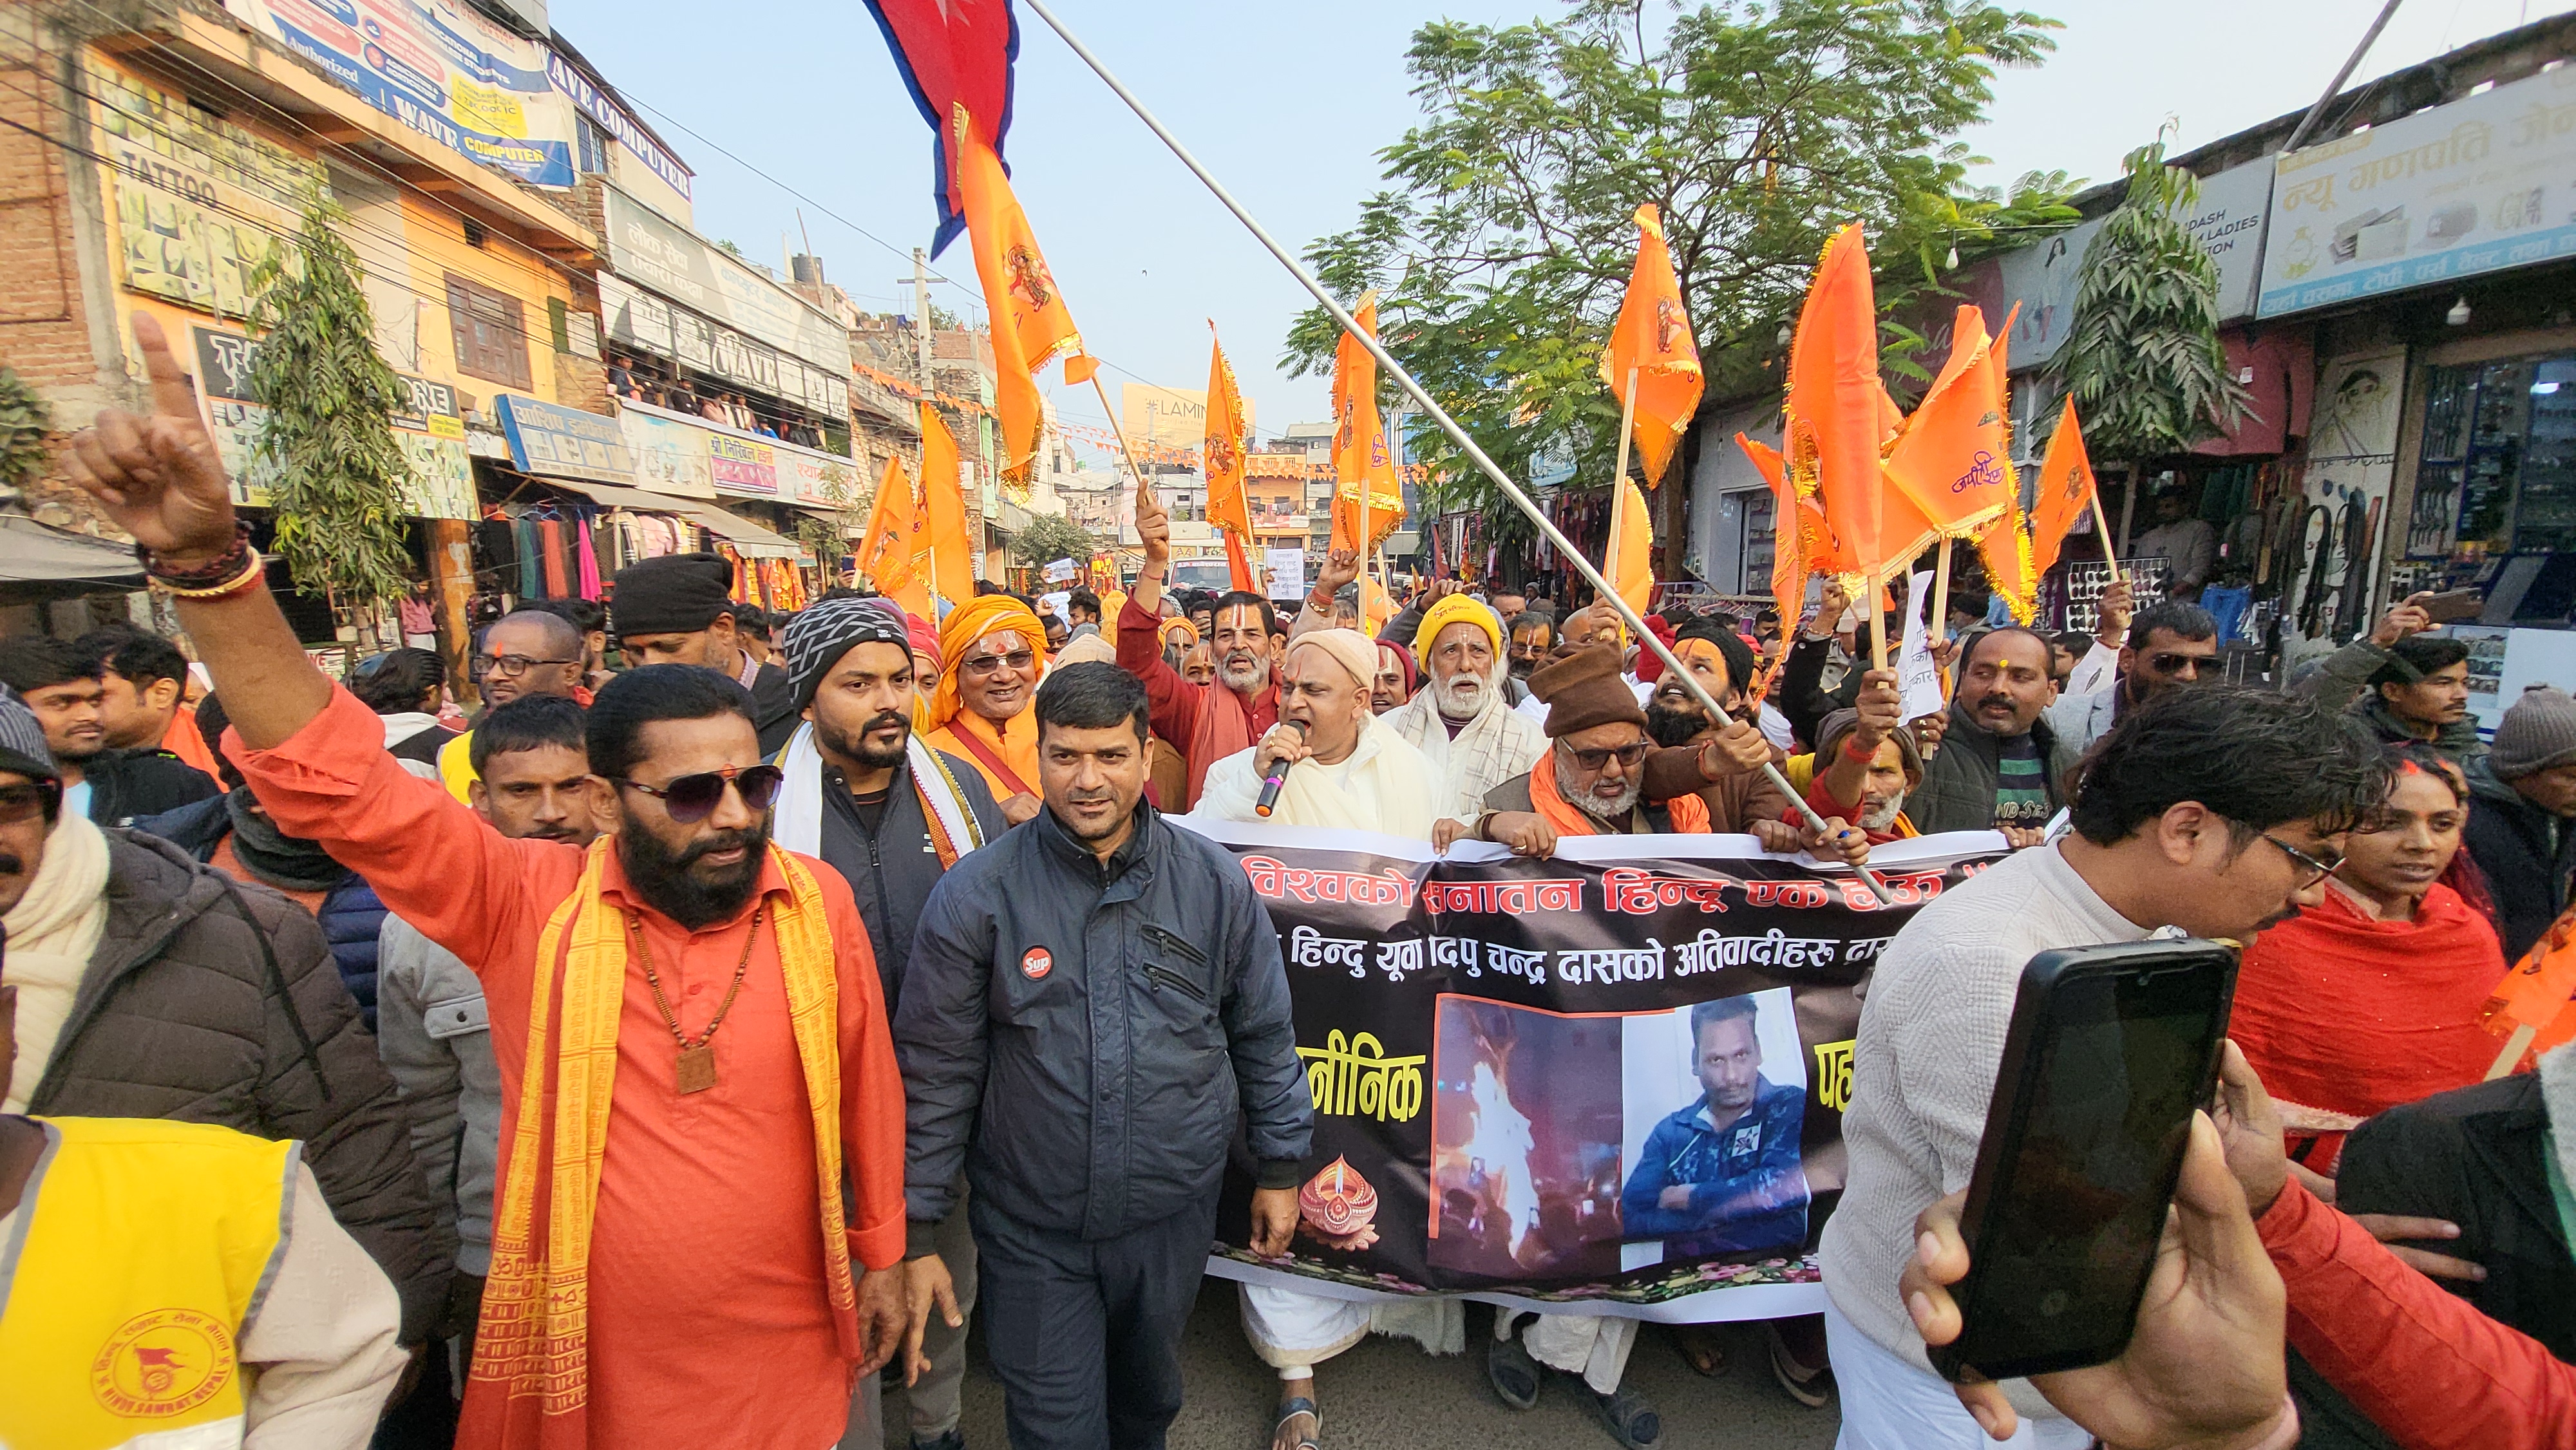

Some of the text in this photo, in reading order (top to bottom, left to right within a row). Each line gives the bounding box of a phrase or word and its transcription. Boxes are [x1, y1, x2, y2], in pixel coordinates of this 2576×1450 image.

[289, 36, 359, 84] Authorized
[423, 17, 479, 64] EDUCATIONAL
[532, 40, 690, 197] WAVE COMPUTER
[463, 136, 545, 162] COMPUTER
[2283, 172, 2338, 212] न्यू
[2347, 120, 2494, 192] गणपति
[121, 149, 218, 209] TATTOO
[2186, 208, 2227, 232] DASH
[2207, 214, 2259, 241] LADIES
[627, 221, 689, 272] लोक सेवा
[1240, 854, 1417, 909] विश्वको
[1422, 877, 1586, 915] सनातन
[1601, 866, 1730, 915] हिन्दू
[1745, 878, 1829, 909] एक
[1025, 956, 1050, 972] Sup
[1291, 925, 1368, 979] हिन्दु
[1376, 938, 1424, 982] यूवा
[1486, 941, 1548, 985] चन्द्र
[1557, 938, 1666, 985] दासको
[101, 1387, 135, 1413] HINDU
[193, 1370, 226, 1400] NEPAL
